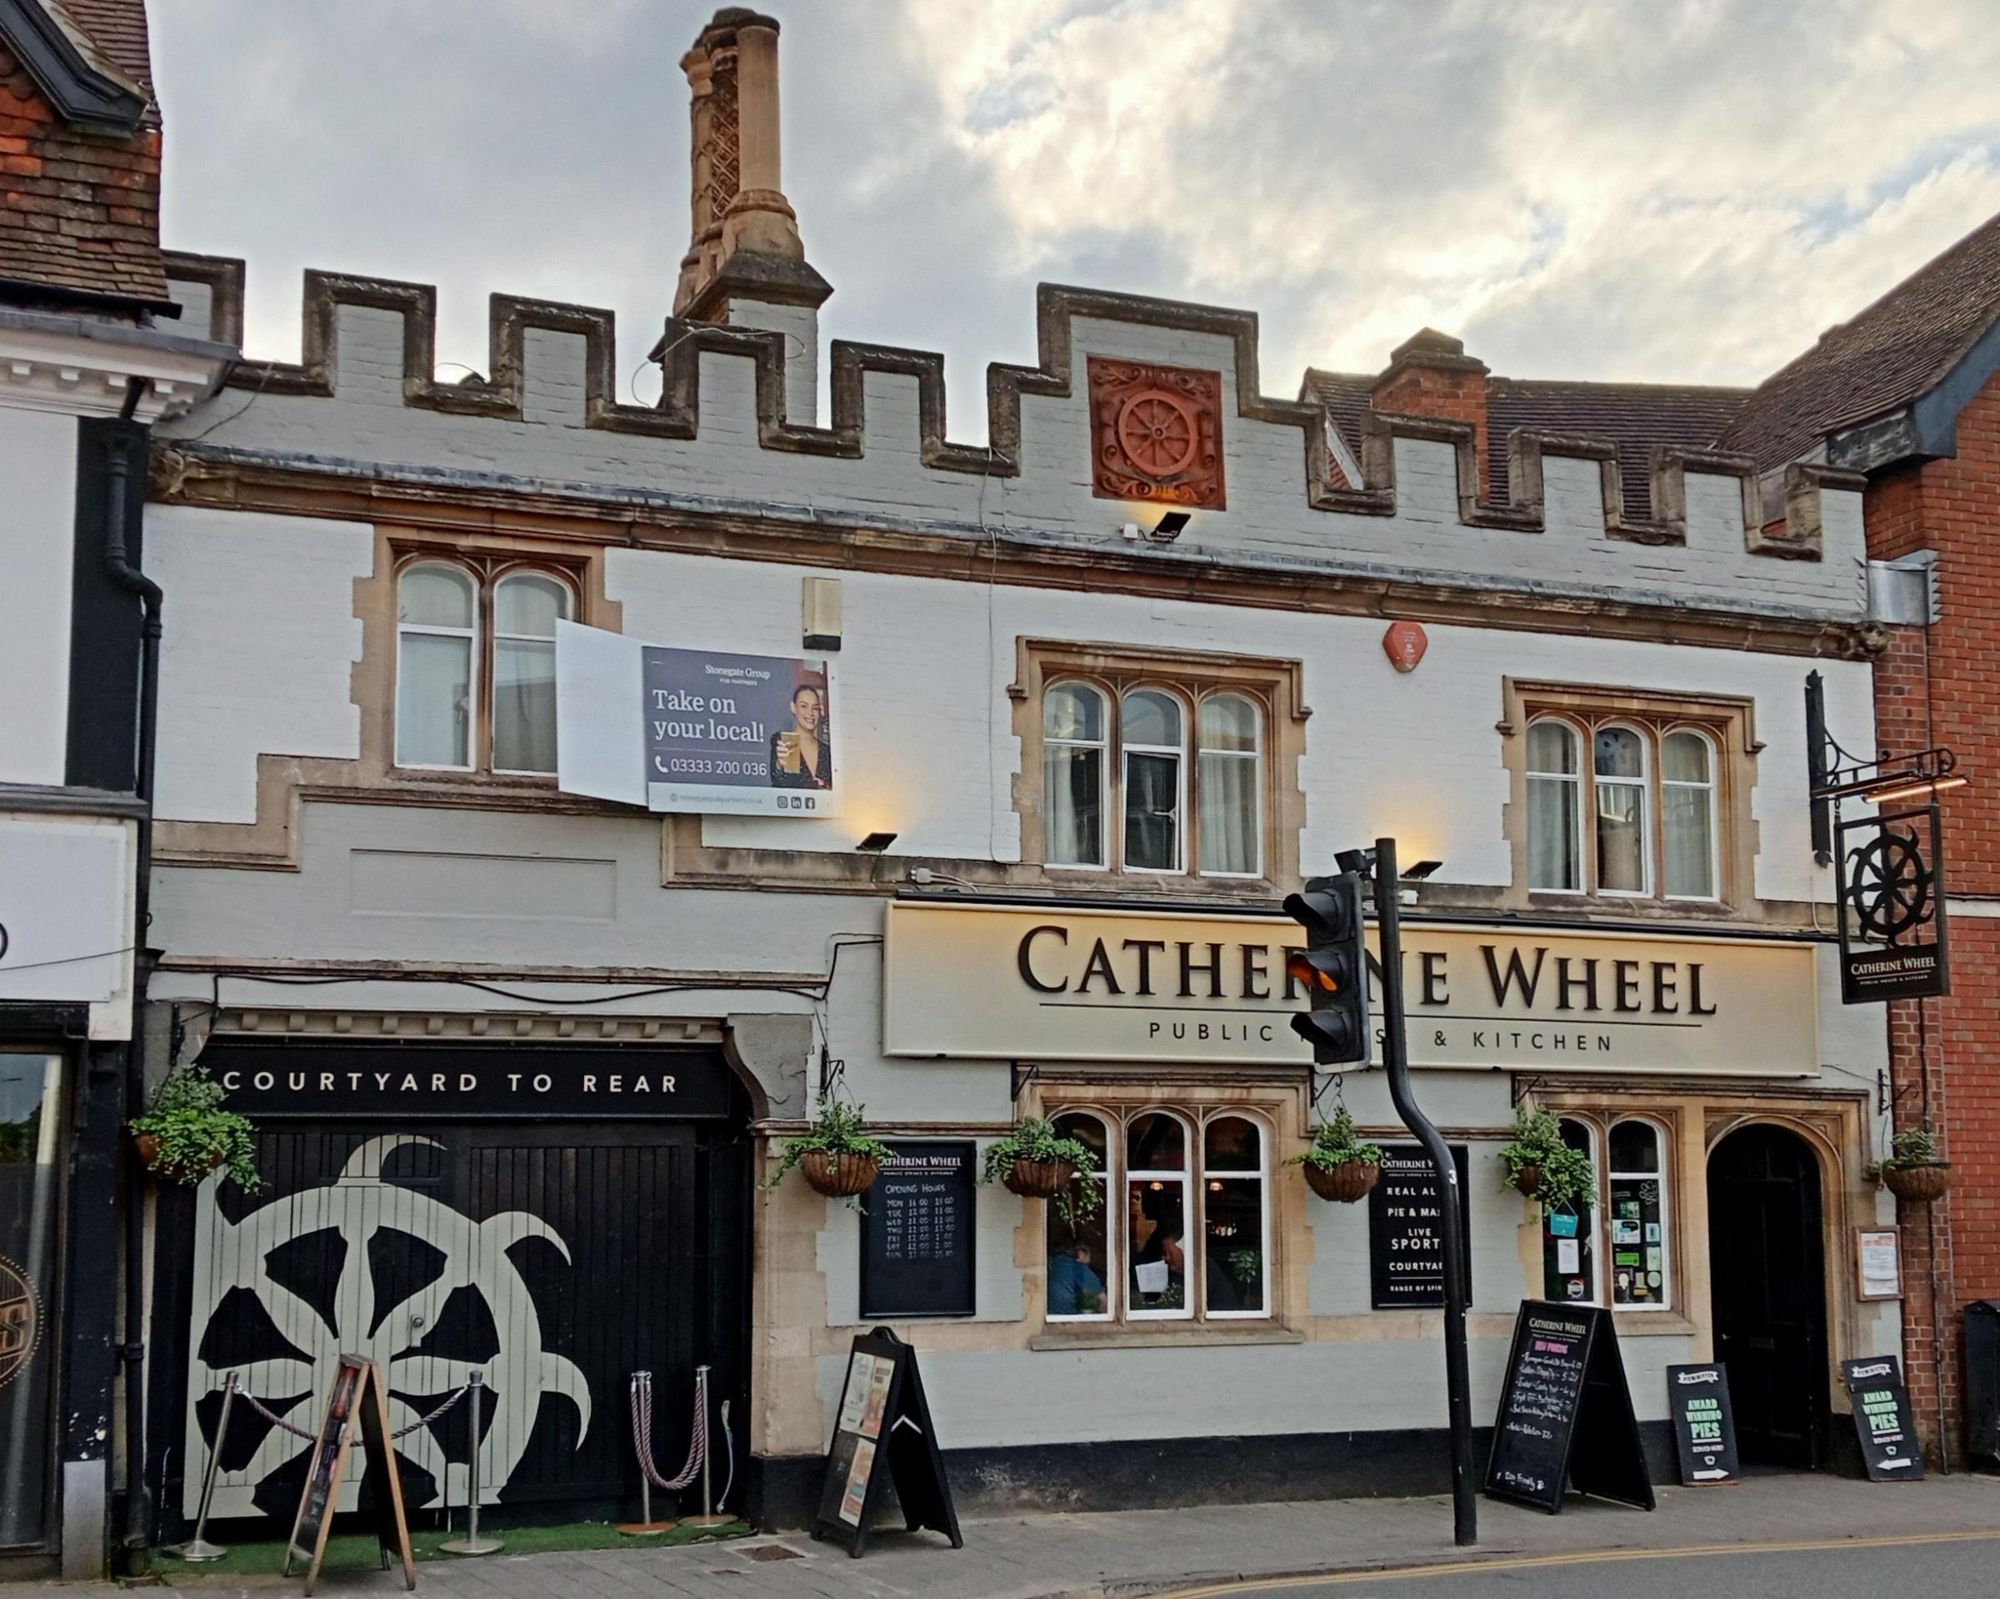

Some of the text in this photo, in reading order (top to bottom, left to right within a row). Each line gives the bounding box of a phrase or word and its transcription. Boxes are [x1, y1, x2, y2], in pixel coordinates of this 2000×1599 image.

[705, 664, 771, 680] Stonegate Group
[653, 689, 737, 714] Take on
[653, 718, 765, 743] your local!
[670, 758, 767, 776] 03333 200 036
[1851, 957, 1937, 976] CATHERINE WHEEL
[1480, 944, 1718, 1015] WHEEL
[1149, 1021, 1612, 1052] PUBLIC & KITCHEN
[222, 1071, 677, 1093] COURTYARD TO REAR
[929, 1155, 962, 1167] WHEEL
[1380, 1159, 1426, 1169] CATHERINE
[1449, 1169, 1458, 1185] 3
[1386, 1187, 1417, 1196] REAL
[1387, 1207, 1406, 1217] PIE
[1408, 1207, 1417, 1217] &
[1407, 1227, 1432, 1237] LIVE
[1391, 1238, 1441, 1250] SPORT
[1528, 1317, 1586, 1334] CATHERINE WHEEL
[1868, 1413, 1899, 1430] PIES
[1690, 1422, 1721, 1438] PIES
